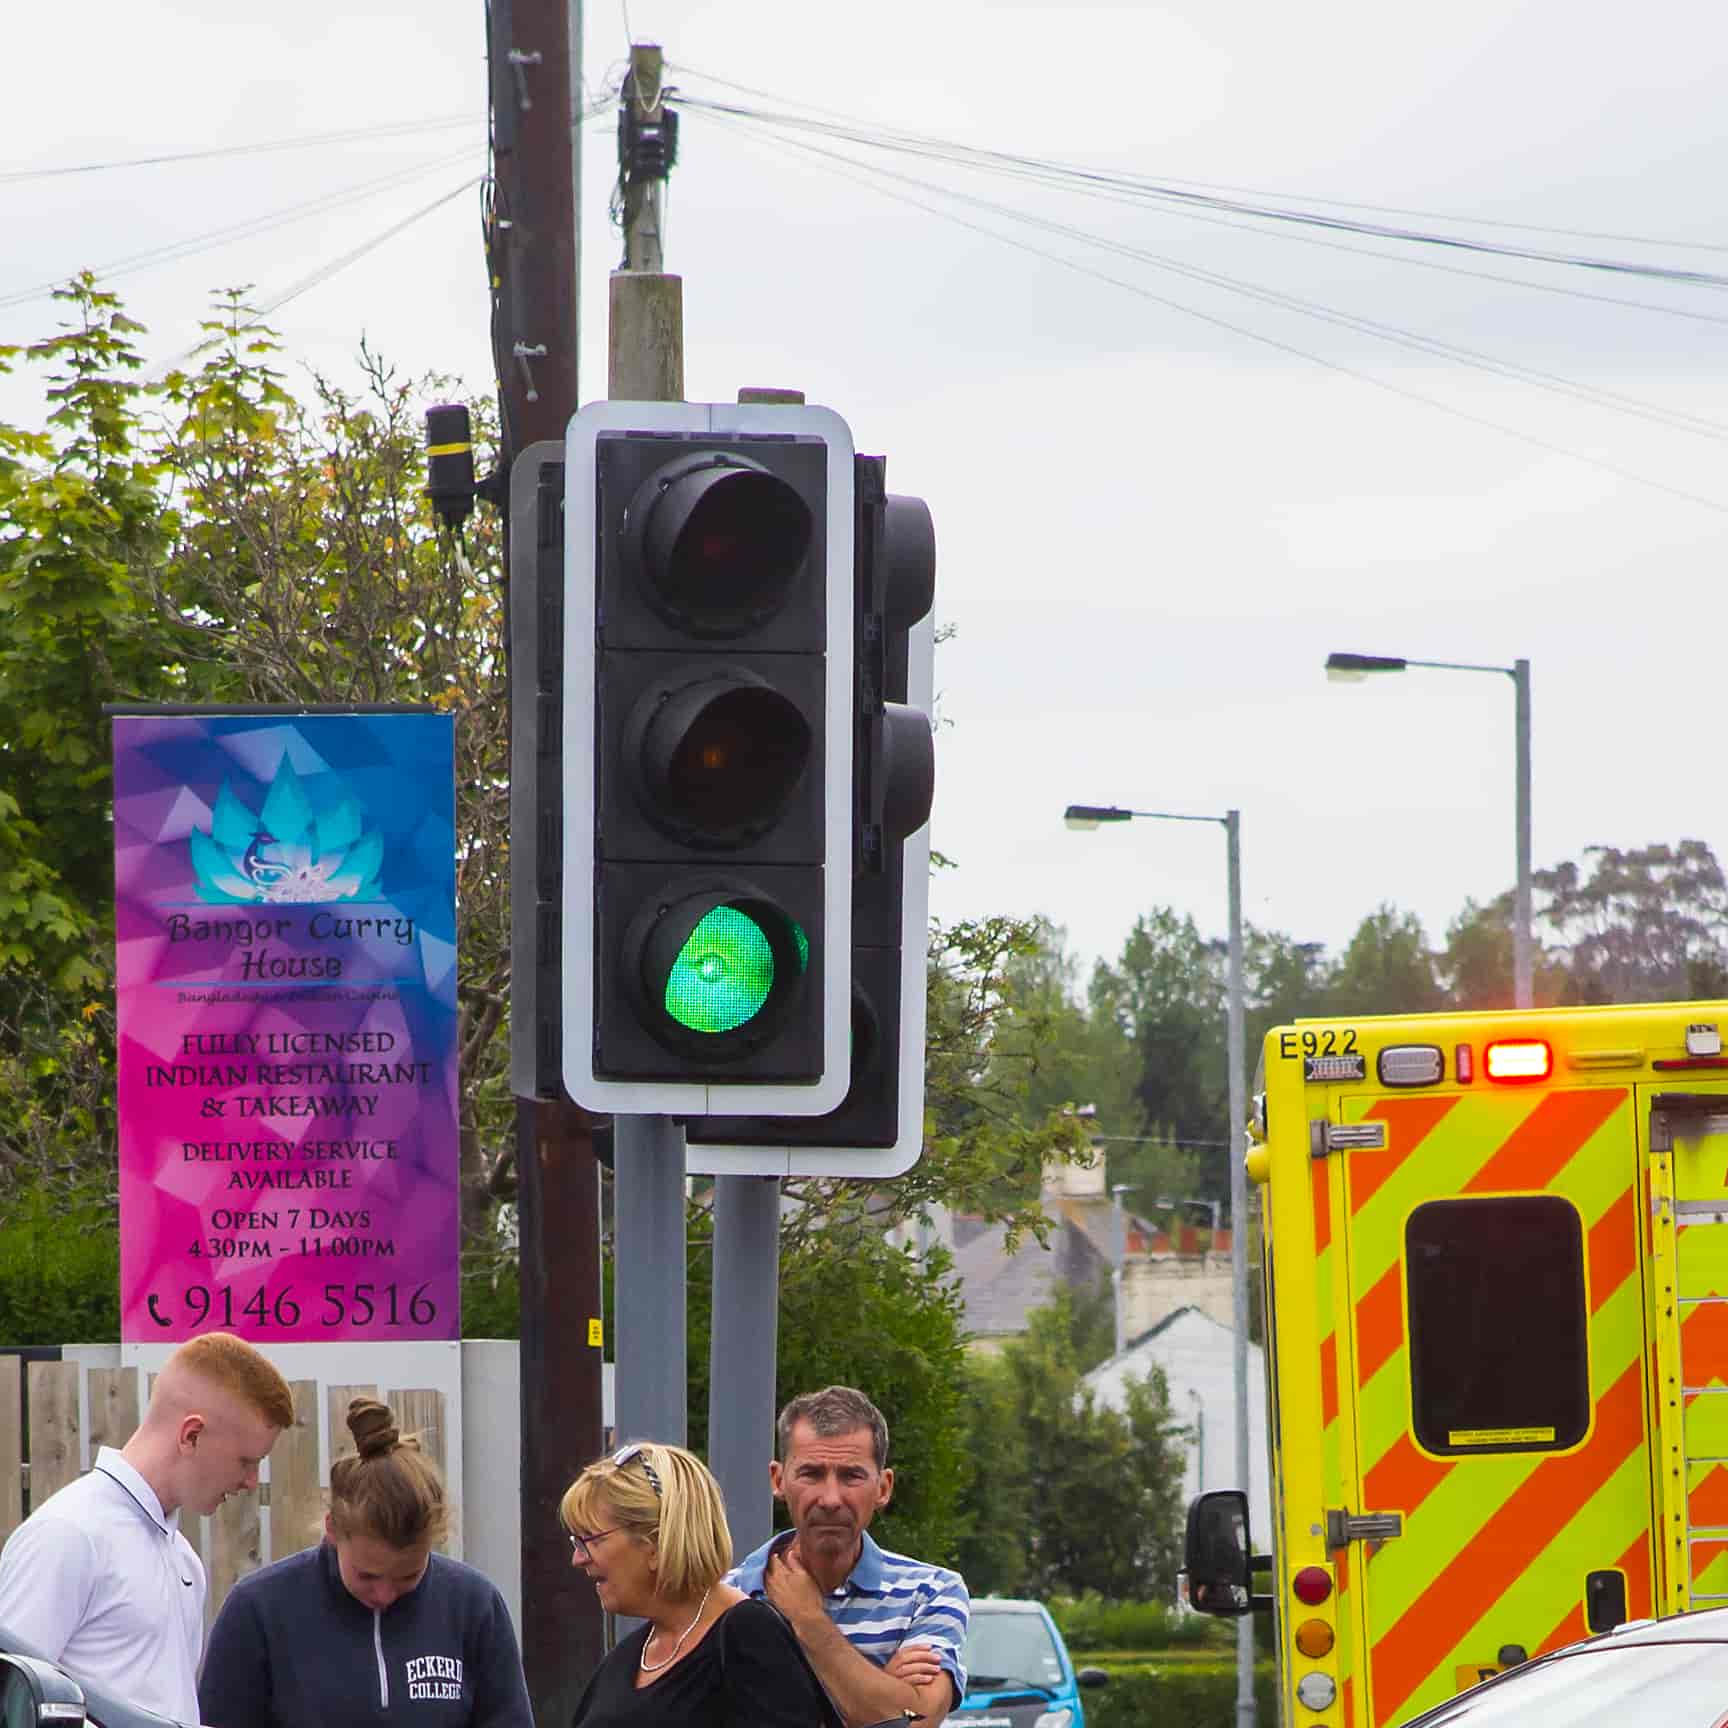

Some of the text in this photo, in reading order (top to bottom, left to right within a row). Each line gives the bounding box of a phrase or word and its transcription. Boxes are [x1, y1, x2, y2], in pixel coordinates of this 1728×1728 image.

[168, 913, 415, 946] Bangor Curry
[241, 948, 343, 981] House
[182, 1032, 395, 1056] FULLY LICENSED
[1280, 1029, 1358, 1058] E922
[146, 1063, 432, 1087] INDIAN RESTAURANT
[200, 1094, 379, 1118] & TAKEAWAY
[182, 1139, 399, 1162] DELIVERY SERVICE
[227, 1168, 353, 1190] AVAILABLE
[287, 1208, 300, 1229] 7
[184, 1281, 437, 1329] 9146 5516
[408, 1682, 463, 1700] COLLEGE
